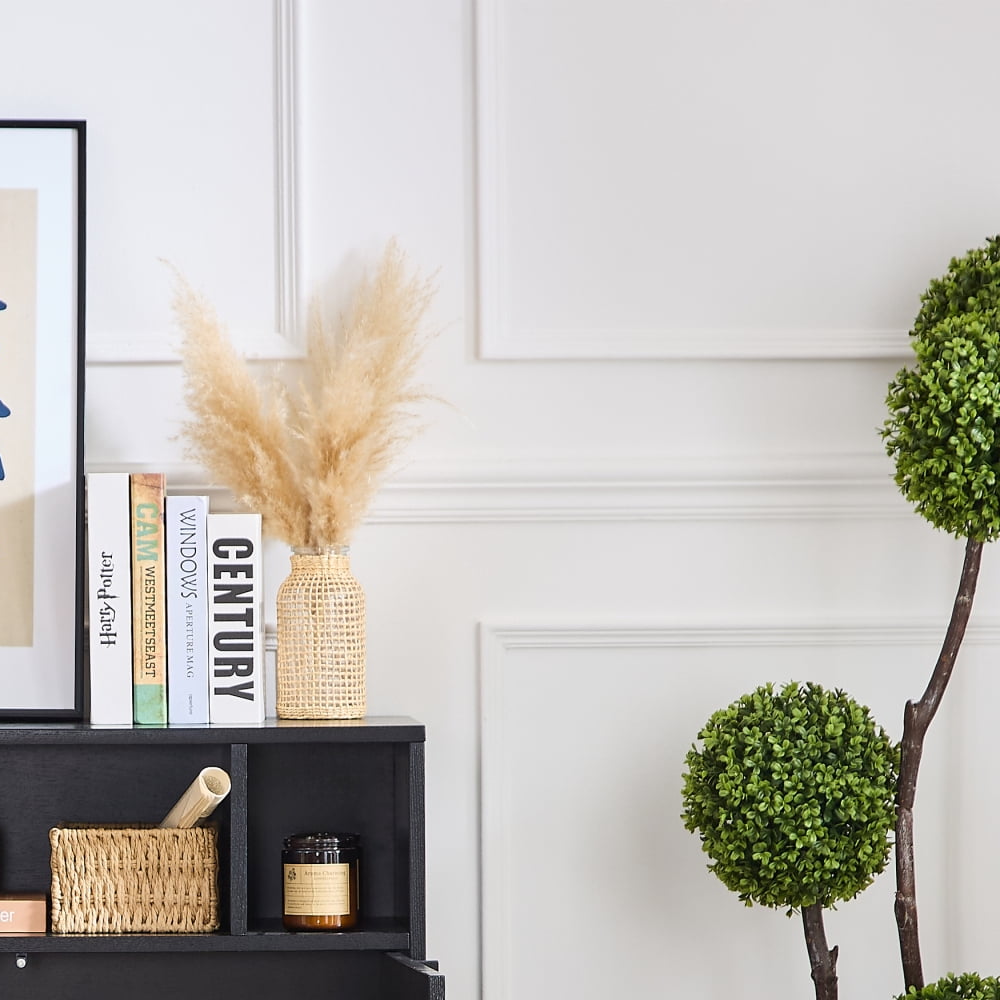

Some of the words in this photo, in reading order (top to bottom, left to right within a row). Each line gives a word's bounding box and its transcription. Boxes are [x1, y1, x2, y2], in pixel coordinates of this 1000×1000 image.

[136, 502, 159, 562] CAM
[179, 508, 198, 599] WINDOWS
[97, 551, 120, 600] Potter
[99, 602, 117, 648] Harry
[185, 602, 194, 654] APERTURE
[213, 538, 254, 701] CENTURY
[186, 655, 195, 679] MAG
